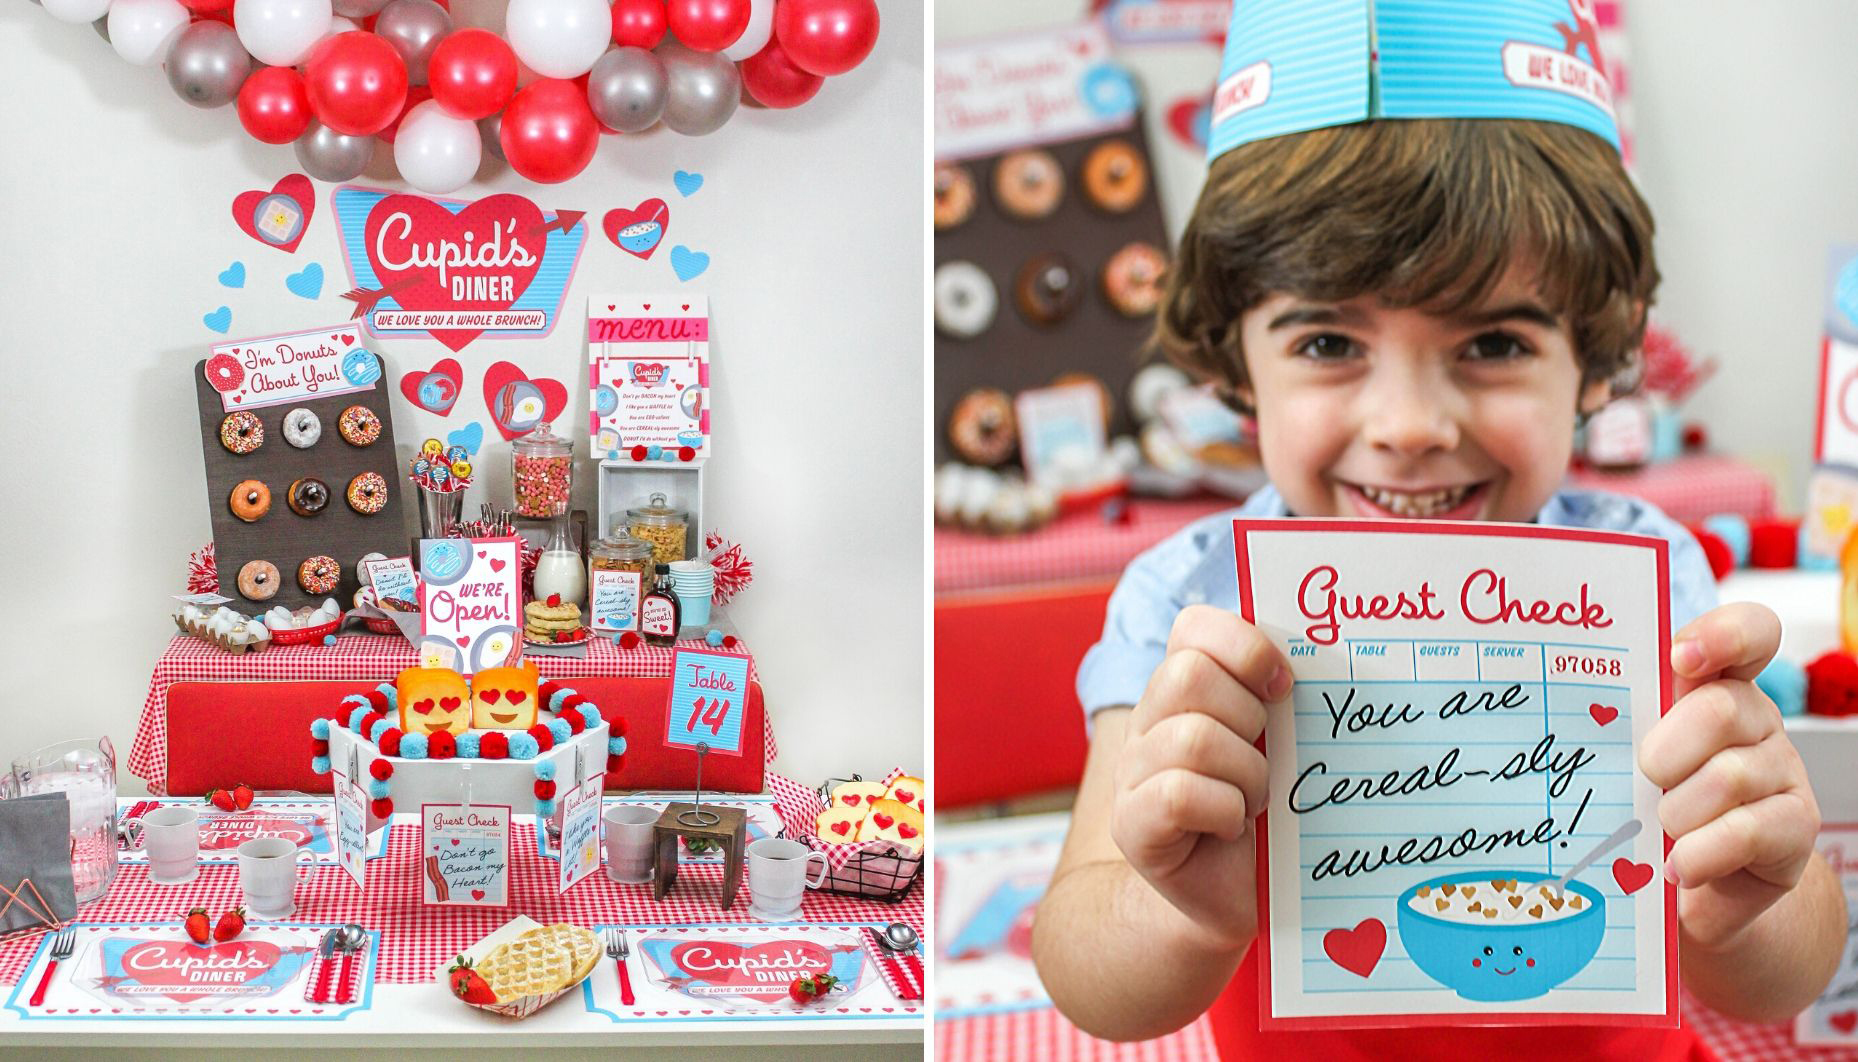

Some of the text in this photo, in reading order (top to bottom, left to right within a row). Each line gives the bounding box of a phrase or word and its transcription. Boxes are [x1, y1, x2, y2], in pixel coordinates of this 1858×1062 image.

[1528, 54, 1552, 80] WE
[376, 211, 537, 288] Cupid's
[452, 275, 514, 302] DINER
[377, 314, 542, 326] WE LOVE YOU A WHOLE BRUNCH!
[596, 319, 699, 340] menu:
[245, 343, 338, 370] I'm Donuts
[250, 364, 341, 394] About You!
[458, 582, 505, 598] WE'RE
[598, 574, 616, 586] Guest
[429, 590, 511, 633] Open!
[643, 610, 673, 624] Sweet!
[1296, 564, 1614, 646] Guest Check
[1289, 644, 1623, 677] DATE TABLE GUESTS SERVER 97058
[686, 663, 737, 692] Table
[686, 695, 731, 737] 14
[1322, 683, 1530, 740] You are
[1287, 733, 1597, 816] Cereal-sly
[210, 821, 255, 829] DINER
[433, 812, 500, 831] Guest Check
[1311, 787, 1594, 882] awesome!
[439, 847, 497, 862] Don't go
[443, 863, 506, 875] Bacon my
[451, 873, 495, 889] Heart!
[129, 946, 270, 977] Cupid's
[681, 947, 827, 977] Cupid's
[189, 971, 247, 983] DINER
